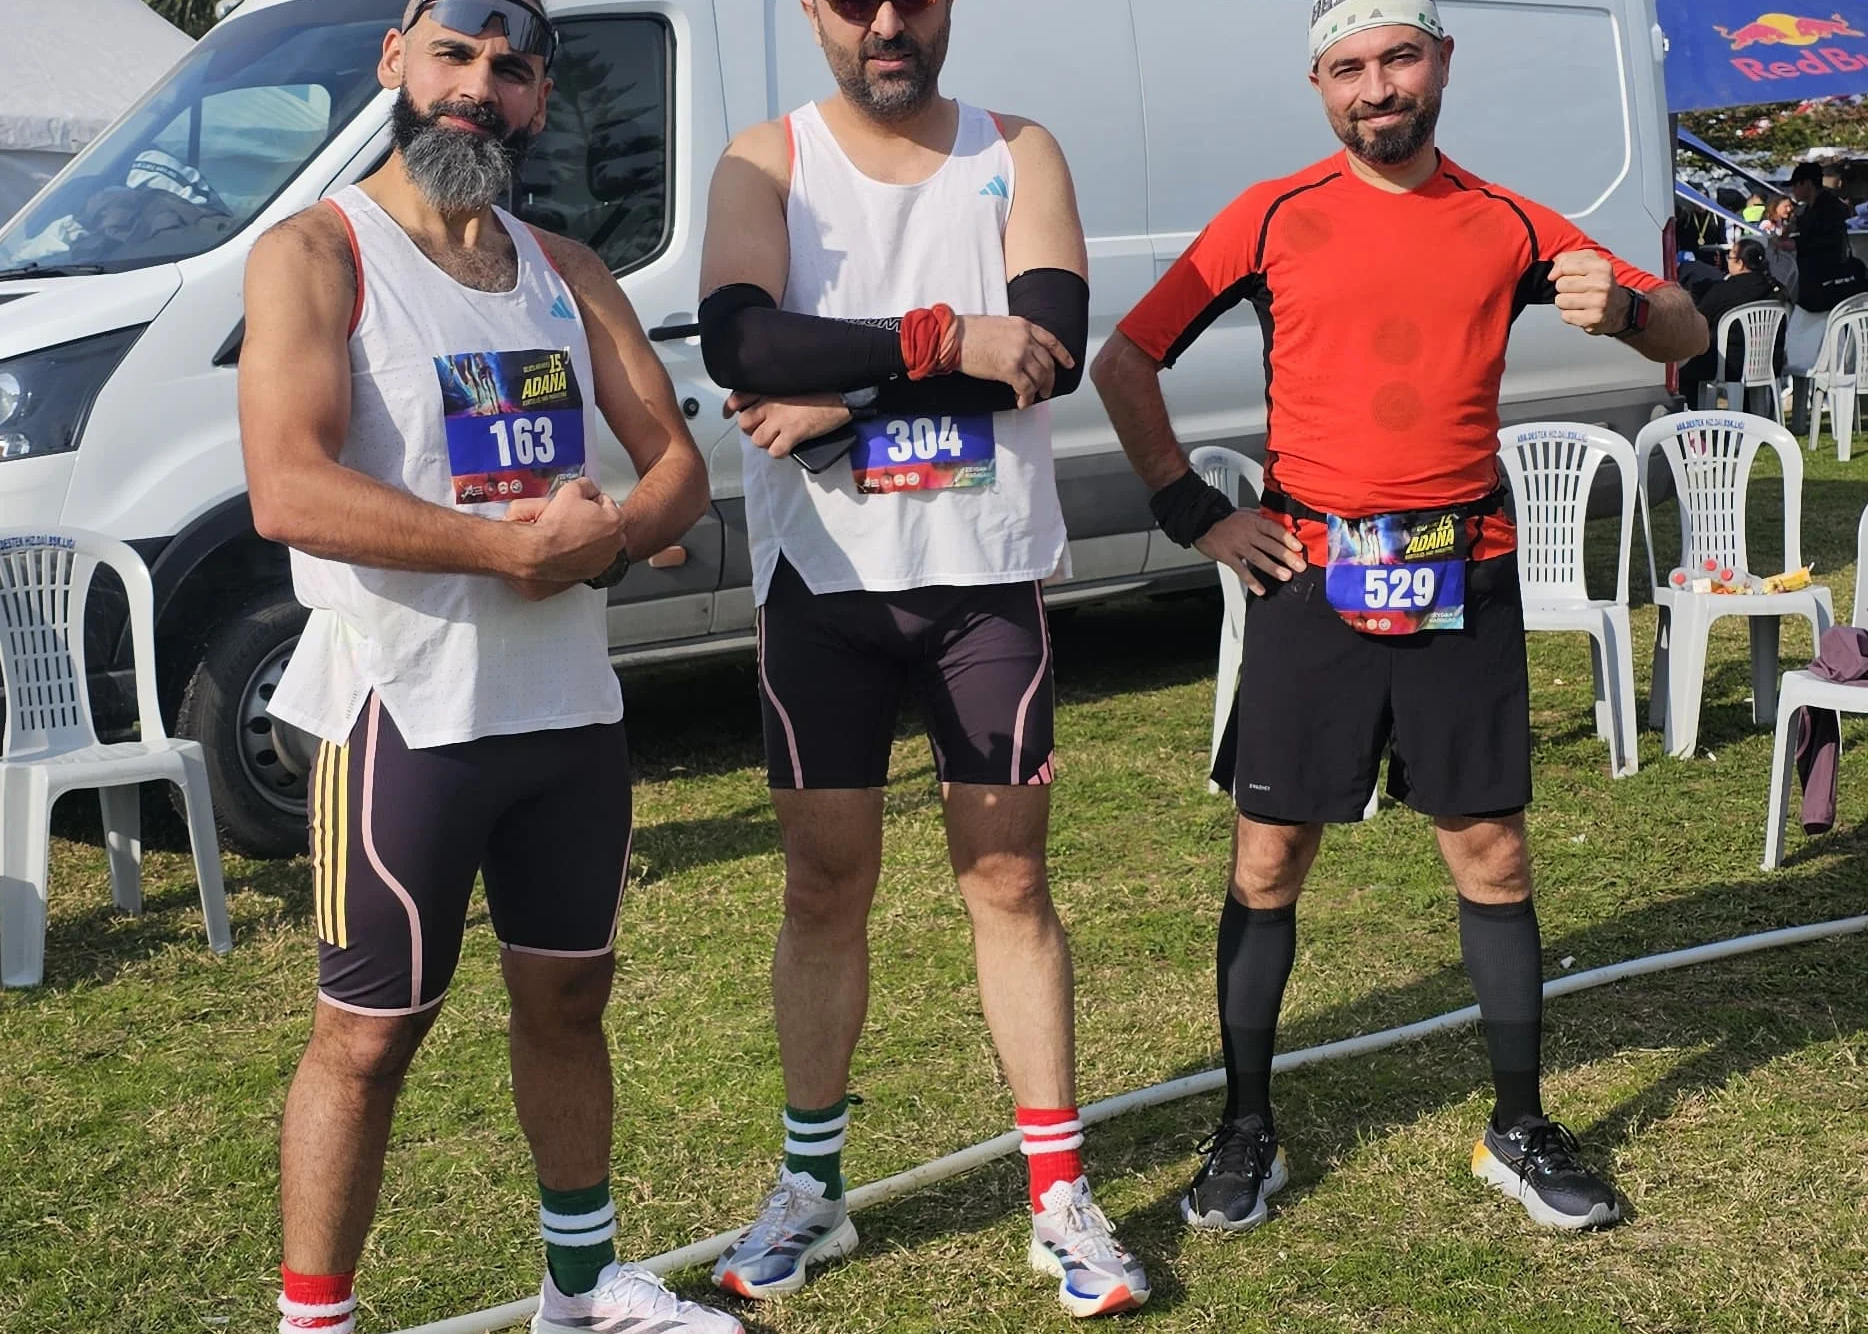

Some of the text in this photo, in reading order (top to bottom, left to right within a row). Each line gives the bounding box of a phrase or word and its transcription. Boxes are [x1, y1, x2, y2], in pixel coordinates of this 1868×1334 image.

[521, 371, 567, 399] ADANA
[490, 416, 556, 467] 163
[886, 416, 962, 462] 304
[1405, 528, 1455, 554] ADANA
[1364, 568, 1435, 609] 529
